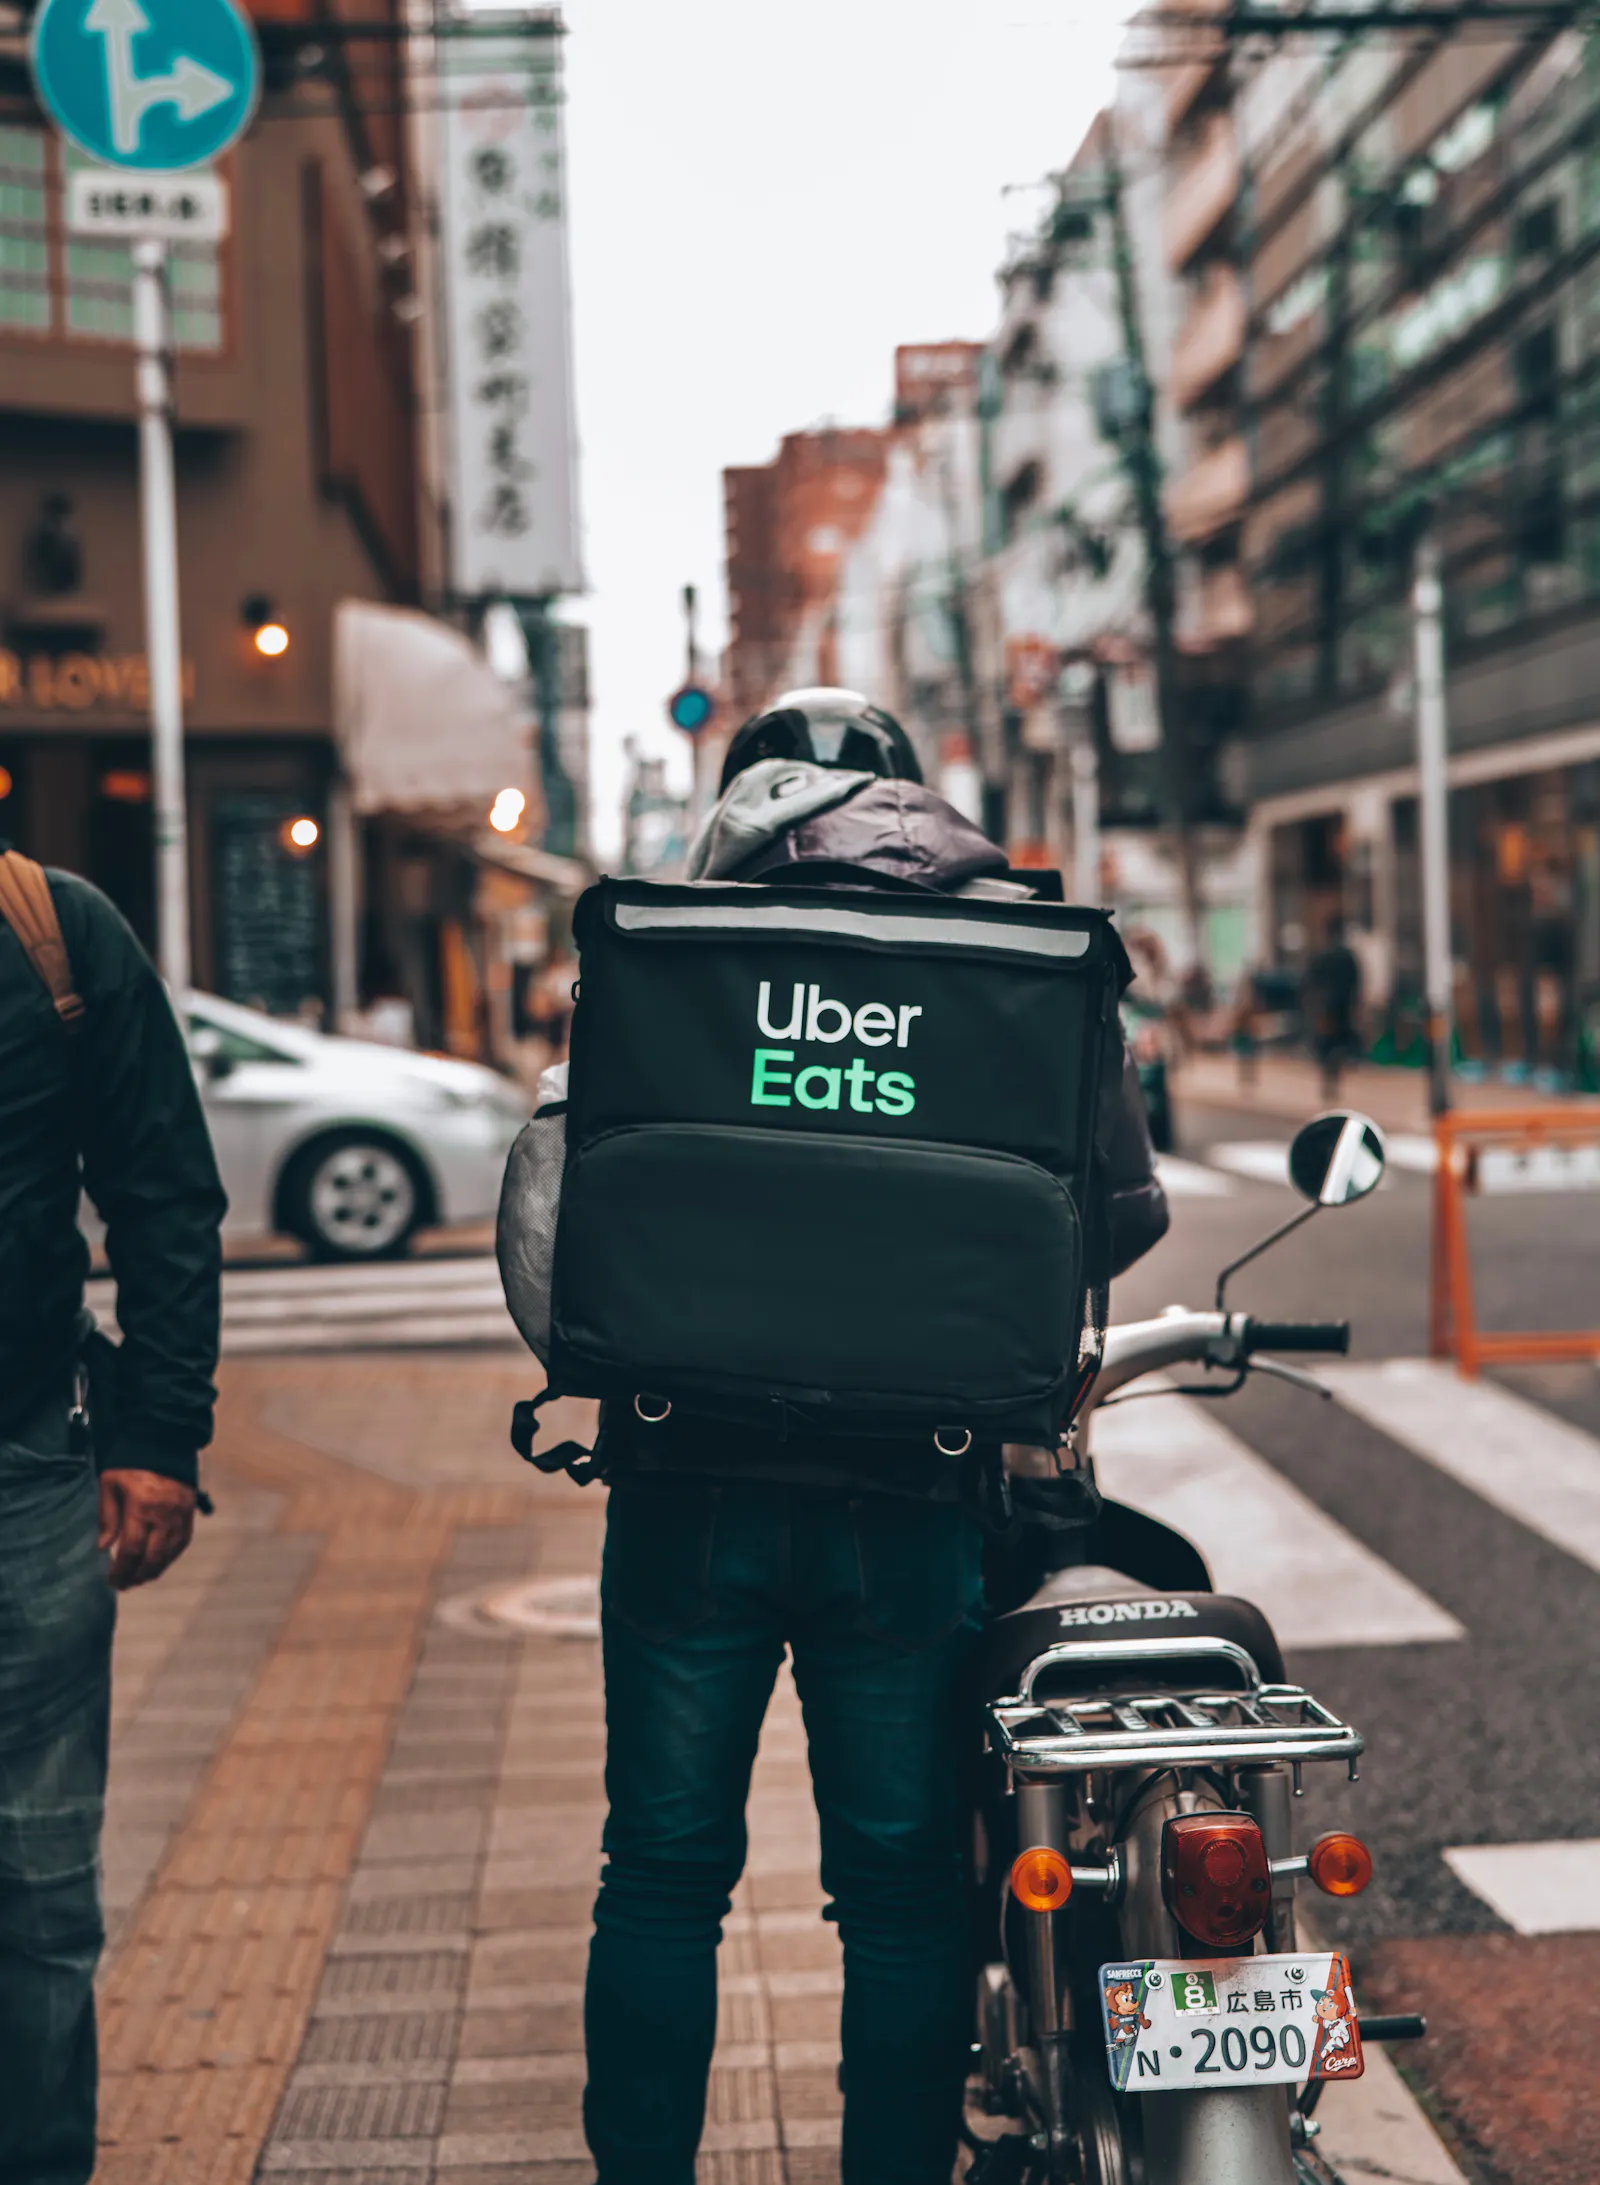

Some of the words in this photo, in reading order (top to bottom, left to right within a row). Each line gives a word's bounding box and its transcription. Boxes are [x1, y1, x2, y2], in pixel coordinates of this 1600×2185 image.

[757, 981, 922, 1048] Uber
[751, 1048, 915, 1116] Eats
[1059, 1600, 1198, 1626] HONDA
[1106, 1968, 1142, 1979] SANFRECCE
[1226, 1989, 1303, 2014] 広島市
[1137, 2050, 1160, 2076] N
[1325, 2056, 1358, 2072] Carp
